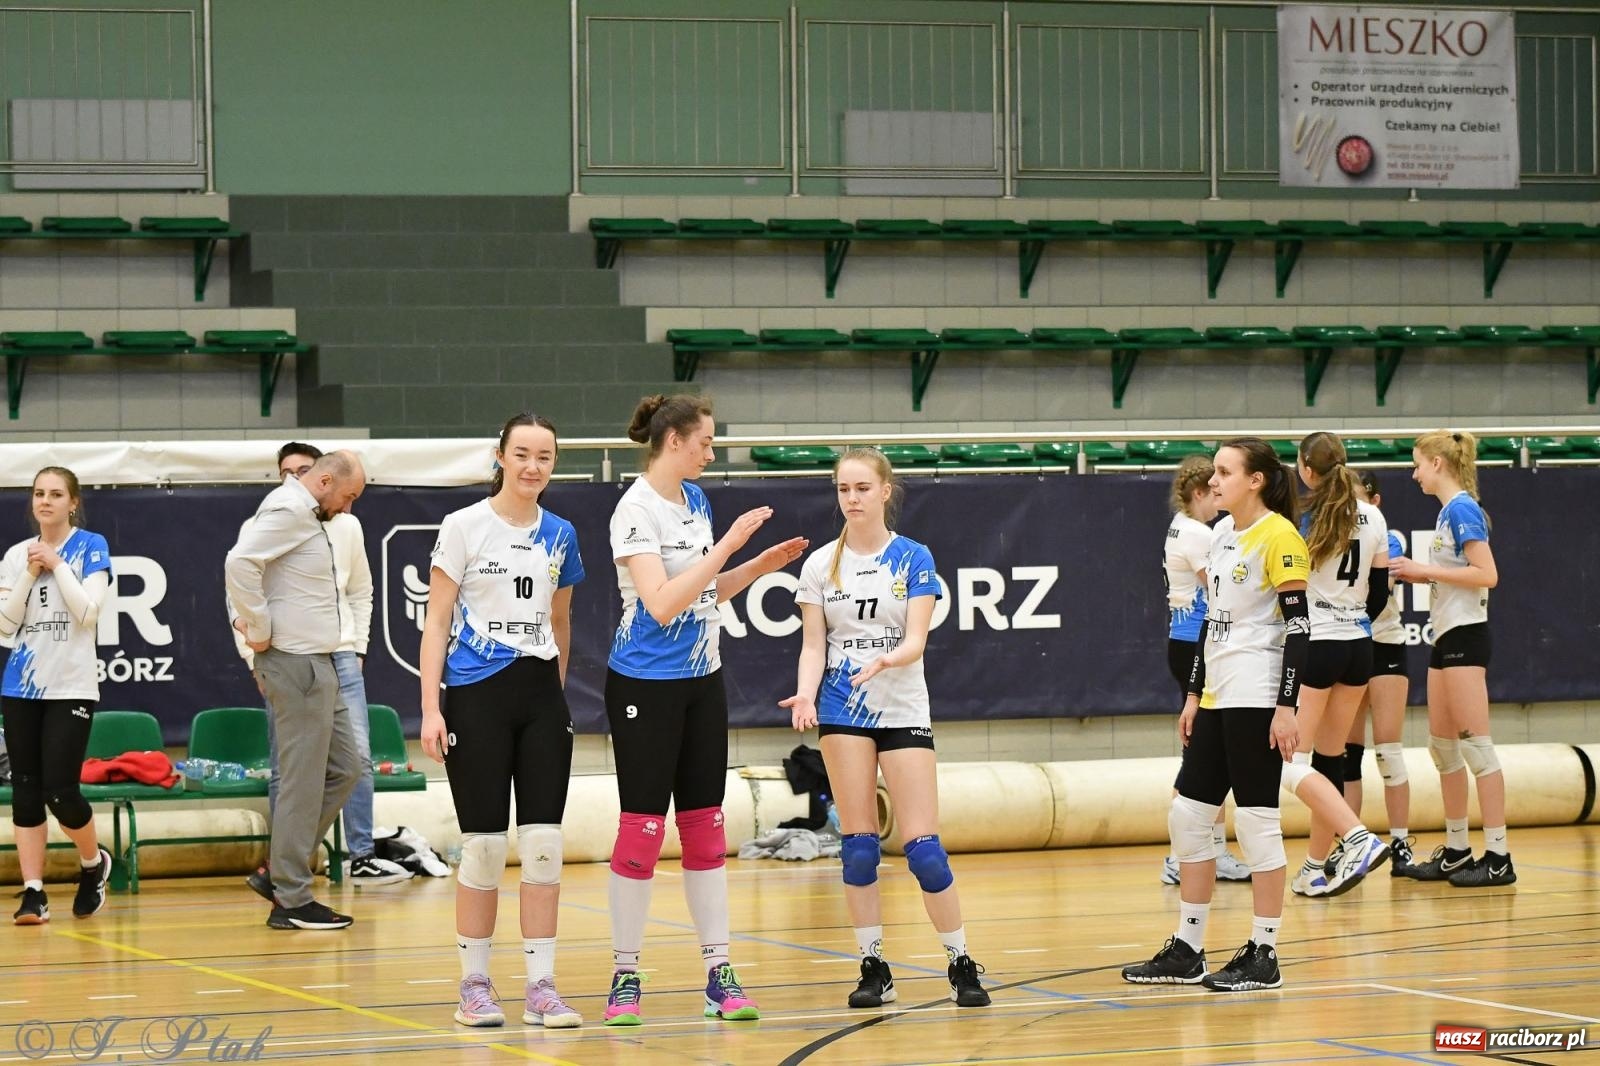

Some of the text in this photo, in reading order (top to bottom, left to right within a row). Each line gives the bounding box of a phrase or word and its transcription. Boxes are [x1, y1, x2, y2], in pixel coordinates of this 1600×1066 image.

[1309, 16, 1488, 57] MIESZKO
[1311, 81, 1509, 97] Operator urządzeń cukierniczych
[1311, 96, 1453, 112] Pracownik produkcyjny
[1385, 120, 1501, 133] Czekamy na Ciebie!
[479, 567, 508, 575] VOLLEY
[1336, 539, 1361, 587] 4
[40, 586, 48, 604] 5
[513, 575, 534, 600] 10
[827, 593, 851, 603] VOLLEY
[855, 597, 879, 620] 77
[1283, 667, 1296, 697] ORACZ
[626, 704, 638, 719] 9
